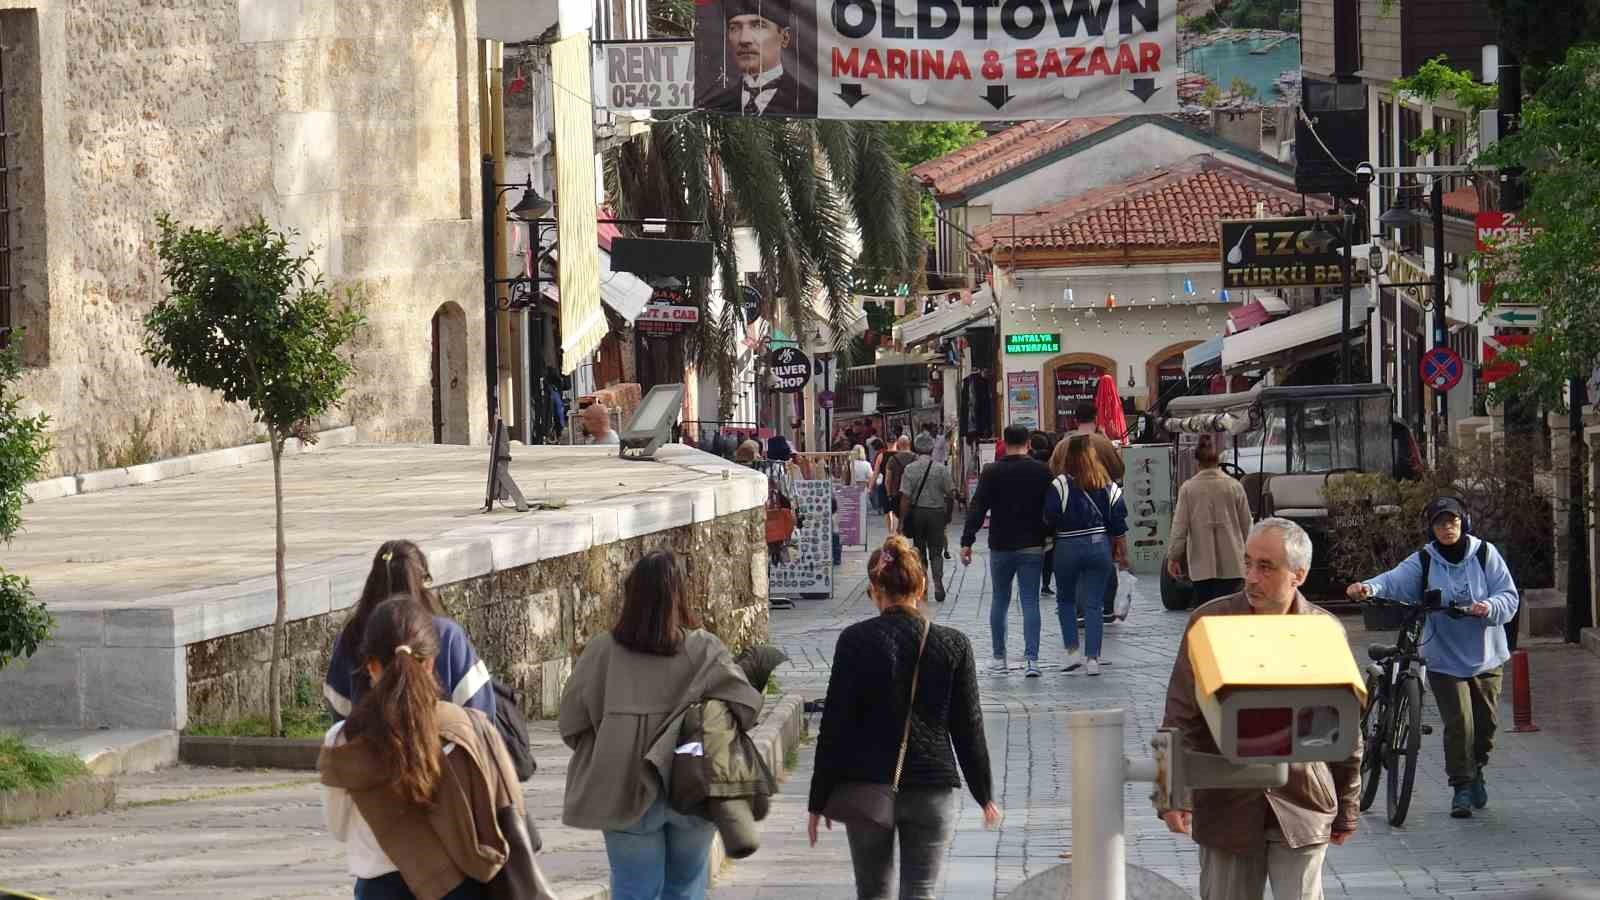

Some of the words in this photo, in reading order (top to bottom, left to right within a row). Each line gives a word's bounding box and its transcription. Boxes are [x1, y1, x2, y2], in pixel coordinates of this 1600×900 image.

[831, 0, 1160, 41] OLDTOWN
[608, 47, 679, 83] RENT
[831, 47, 972, 81] MARINA
[981, 48, 1005, 81] &
[1015, 42, 1162, 79] BAZAAR
[612, 84, 662, 108] 0542
[1228, 262, 1307, 286] TÜRKÜ
[1314, 264, 1345, 285] BA
[672, 309, 698, 320] CAR
[1011, 334, 1052, 343] ANTALYA
[770, 364, 807, 376] SILVER
[774, 377, 804, 388] SHOP
